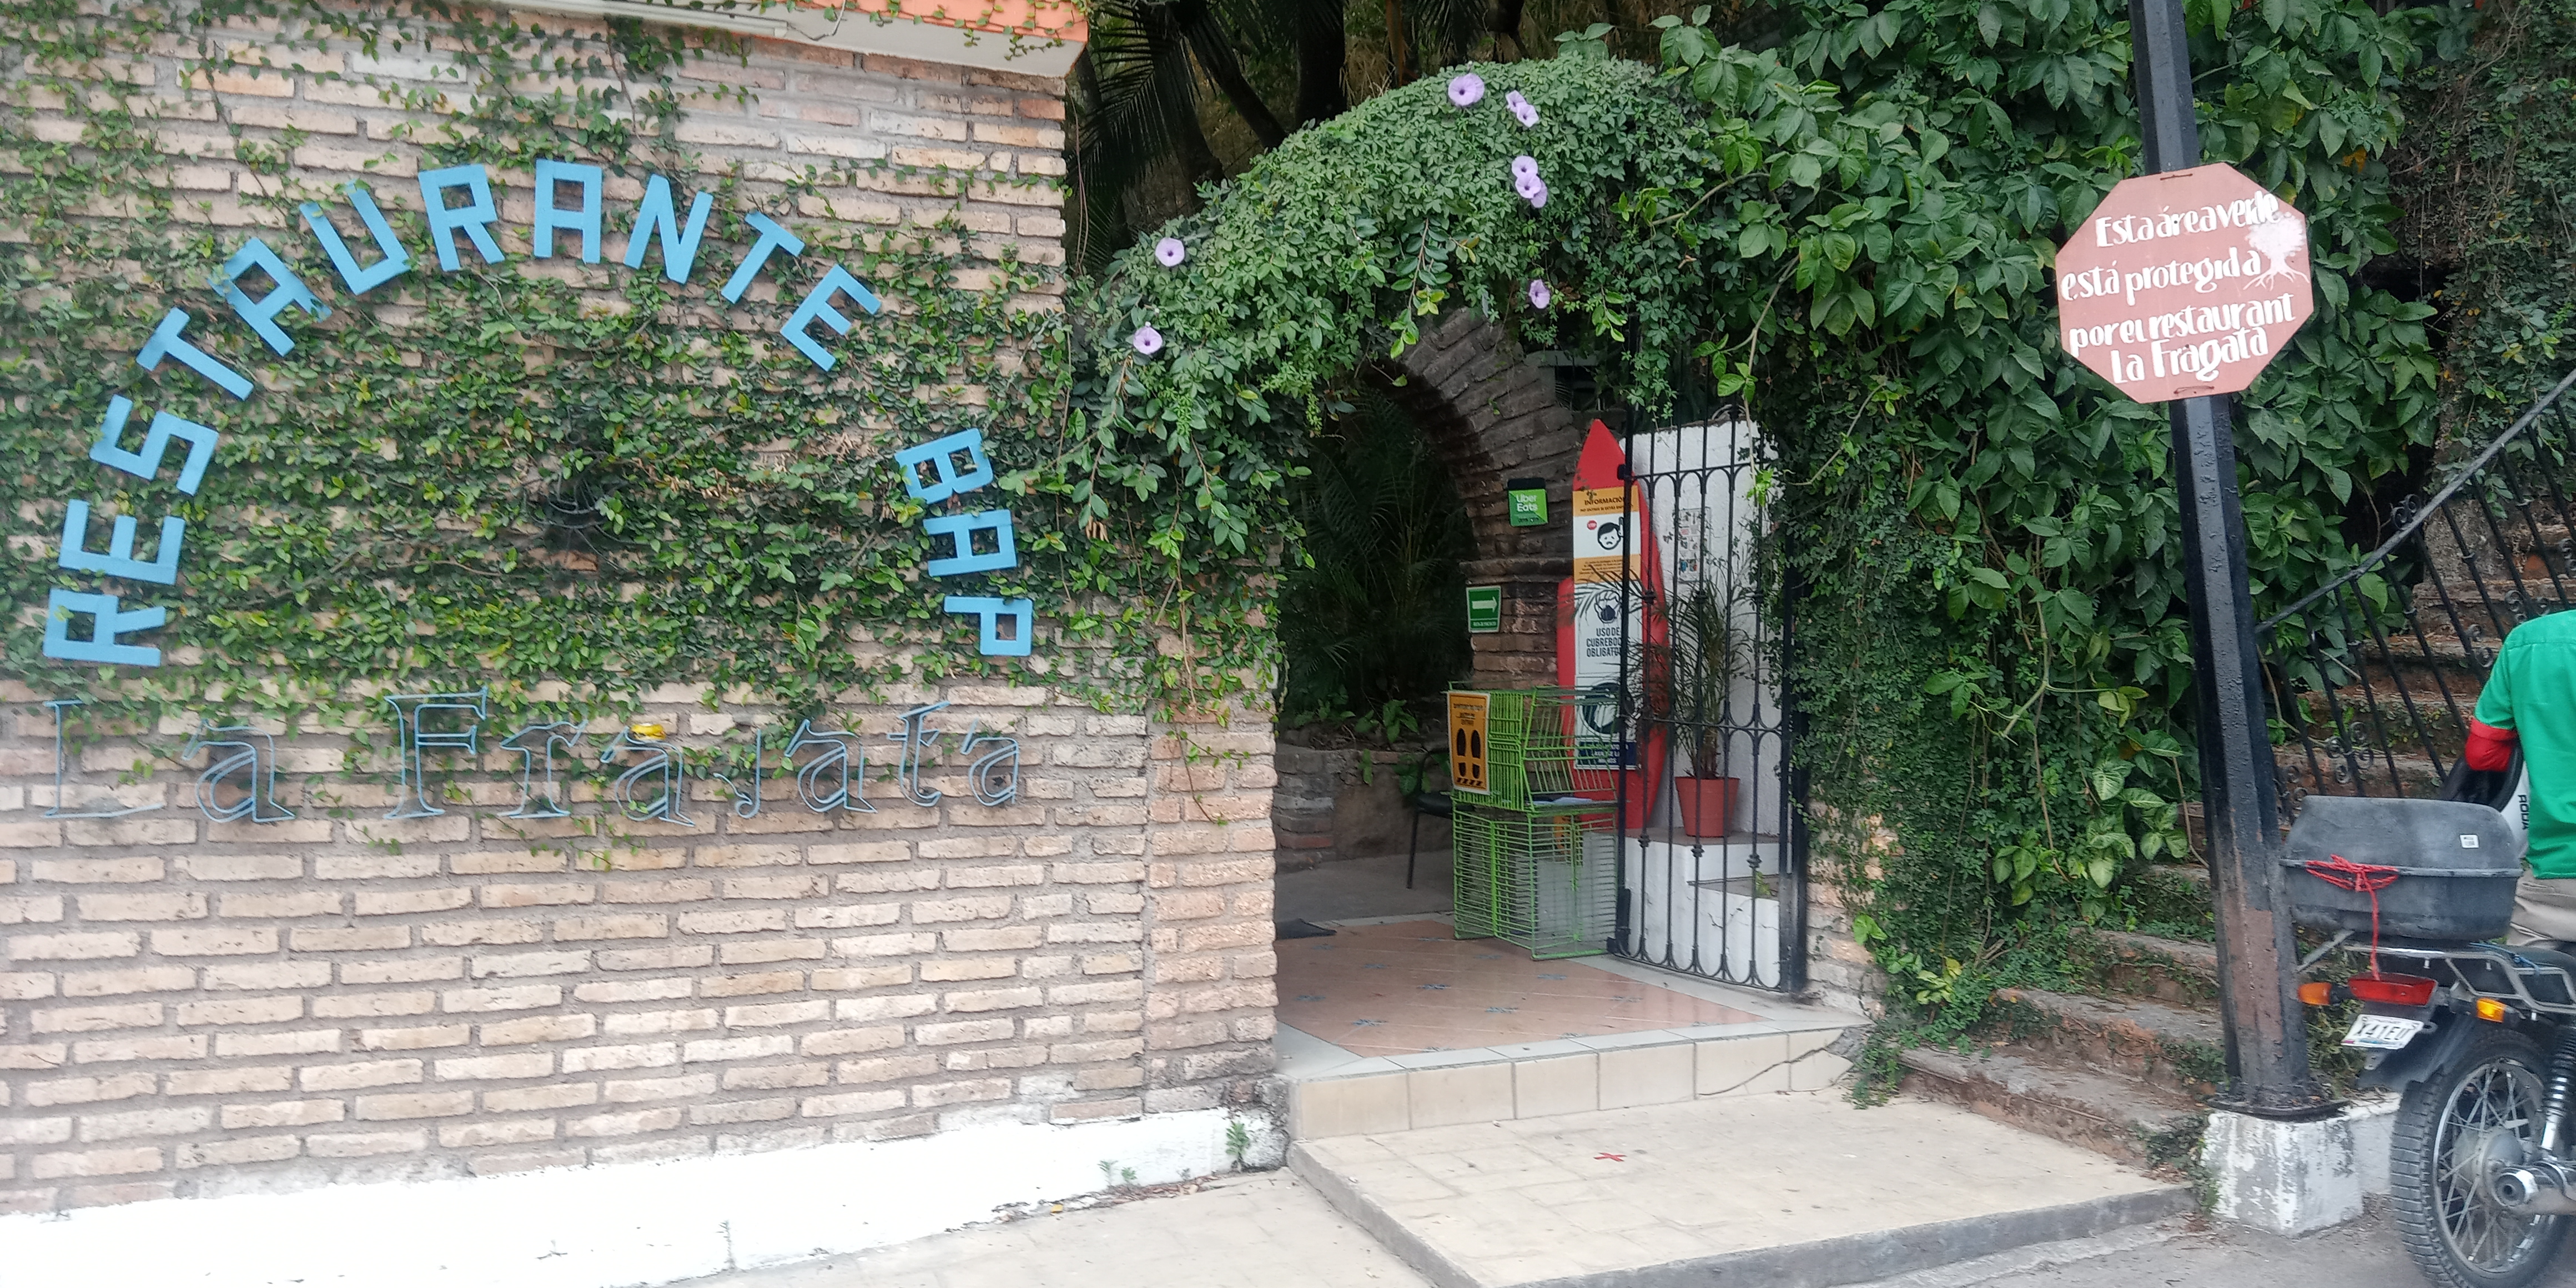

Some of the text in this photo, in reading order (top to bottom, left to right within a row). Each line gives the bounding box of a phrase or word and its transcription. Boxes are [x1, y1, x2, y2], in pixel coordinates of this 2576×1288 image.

[2095, 213, 2154, 248] Esta
[2060, 246, 2261, 306] está protegida
[2069, 322, 2120, 359] por
[2149, 293, 2296, 339] restaurant
[2110, 327, 2268, 384] La Fragata
[43, 159, 882, 667] RESTAURANTE
[1516, 493, 1537, 503] Uber
[1517, 502, 1538, 512] Eats
[1584, 496, 1624, 505] INFORMACIÓ
[1596, 626, 1621, 637] USO DE
